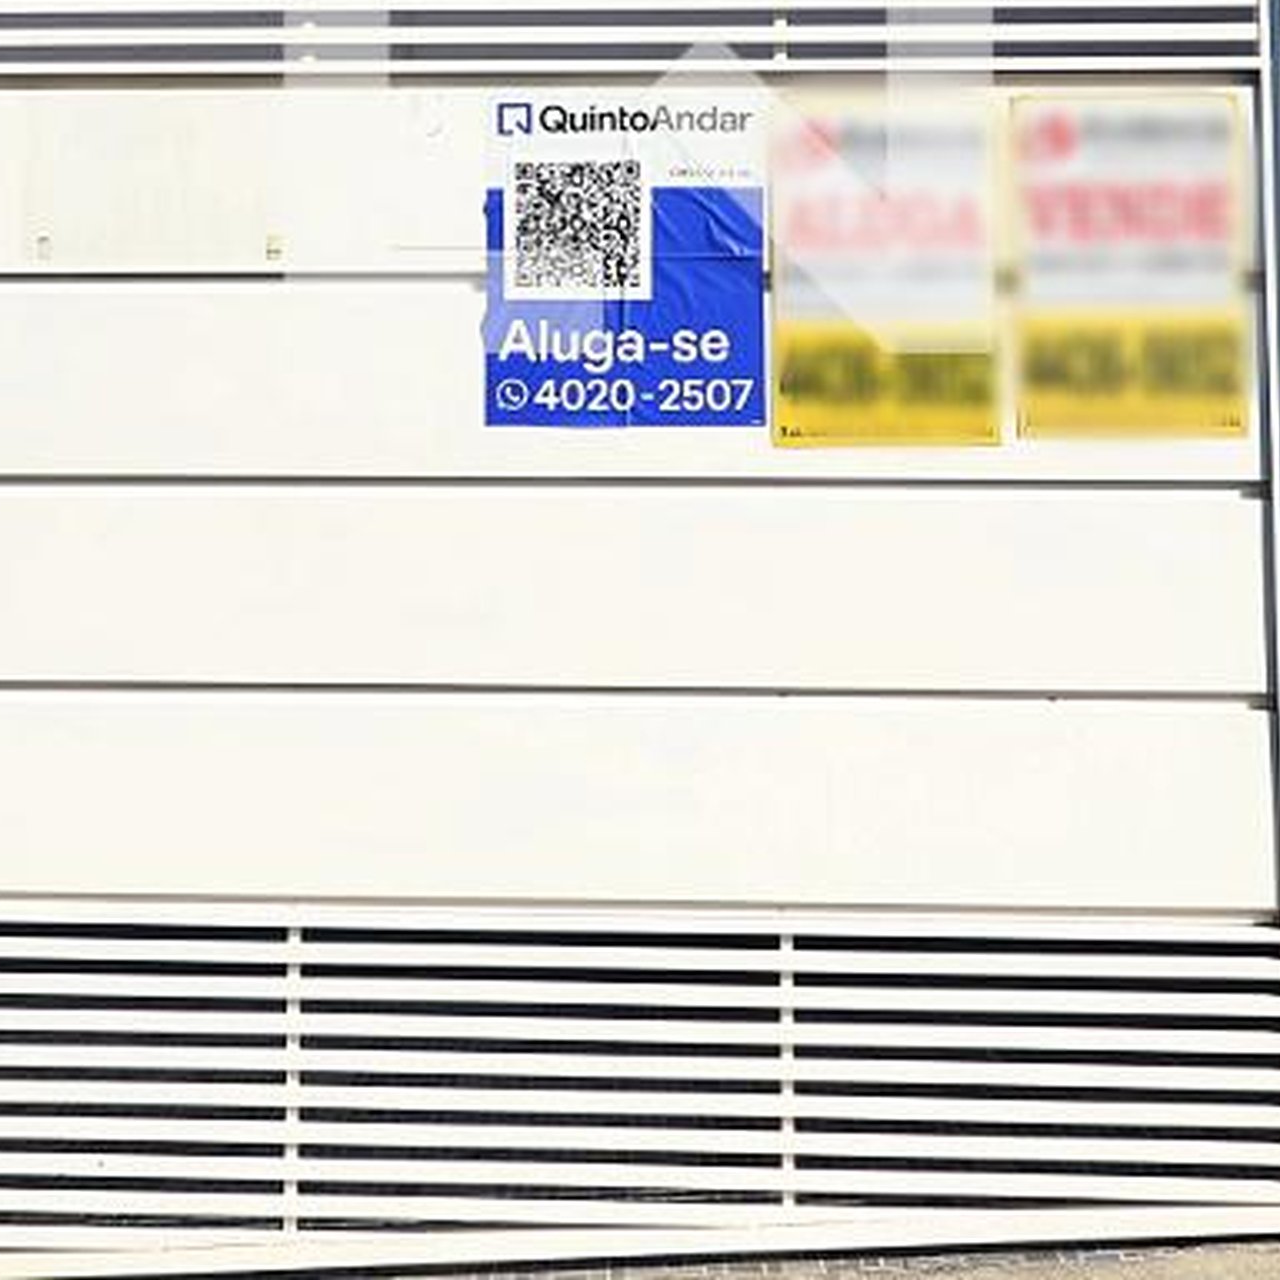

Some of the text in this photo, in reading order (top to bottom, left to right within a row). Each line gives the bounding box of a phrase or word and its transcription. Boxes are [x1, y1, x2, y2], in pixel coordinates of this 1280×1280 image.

[539, 105, 752, 133] QuintoAndar
[498, 319, 730, 373] Aluga-se
[533, 379, 754, 411] 4020-2507
